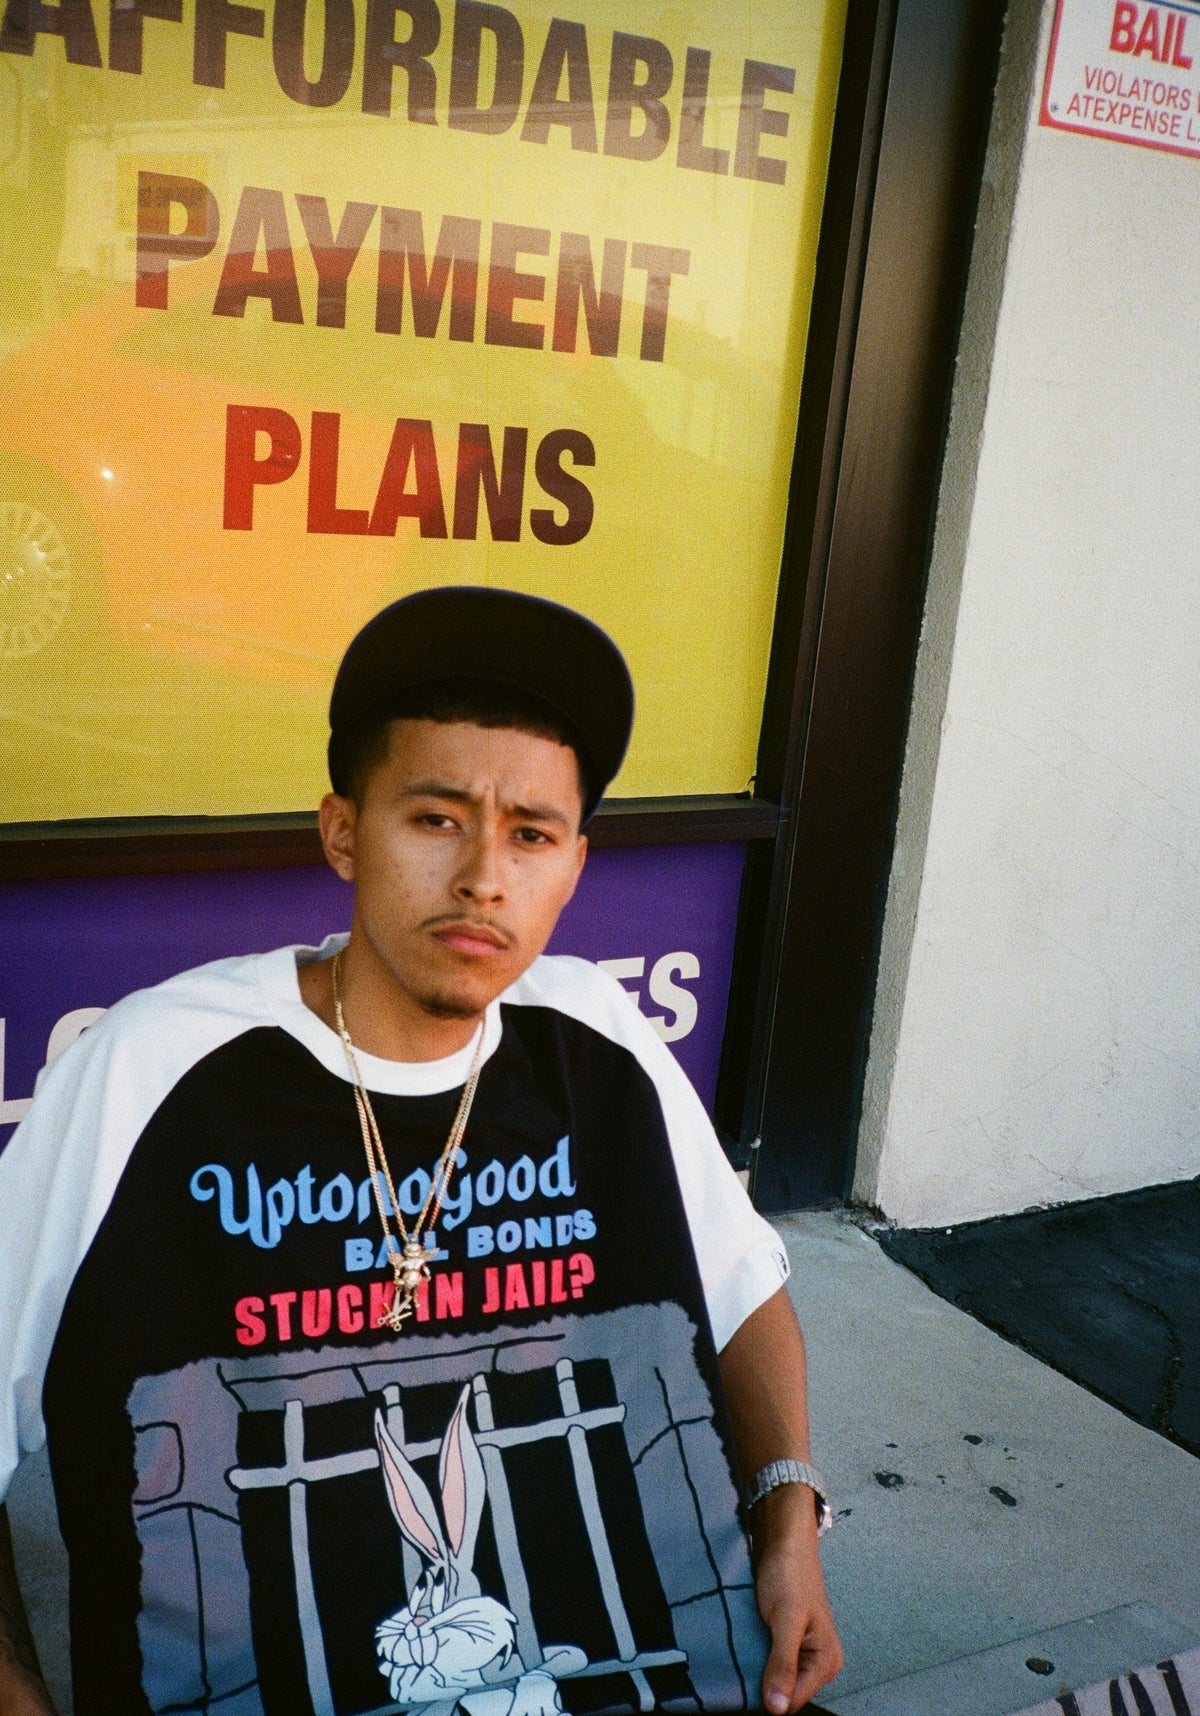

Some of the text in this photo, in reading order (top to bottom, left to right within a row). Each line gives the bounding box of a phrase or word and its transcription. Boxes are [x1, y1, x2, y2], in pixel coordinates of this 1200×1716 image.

[1109, 1, 1194, 70] BAIL
[1066, 92, 1183, 138] ATEXPENSE
[1084, 65, 1192, 112] VIOLATORS
[135, 170, 690, 363] PAYMENT
[222, 403, 597, 546] PLANS
[344, 1208, 597, 1272] BAL BONDS
[234, 1252, 596, 1347] STUCK IN JAIL?
